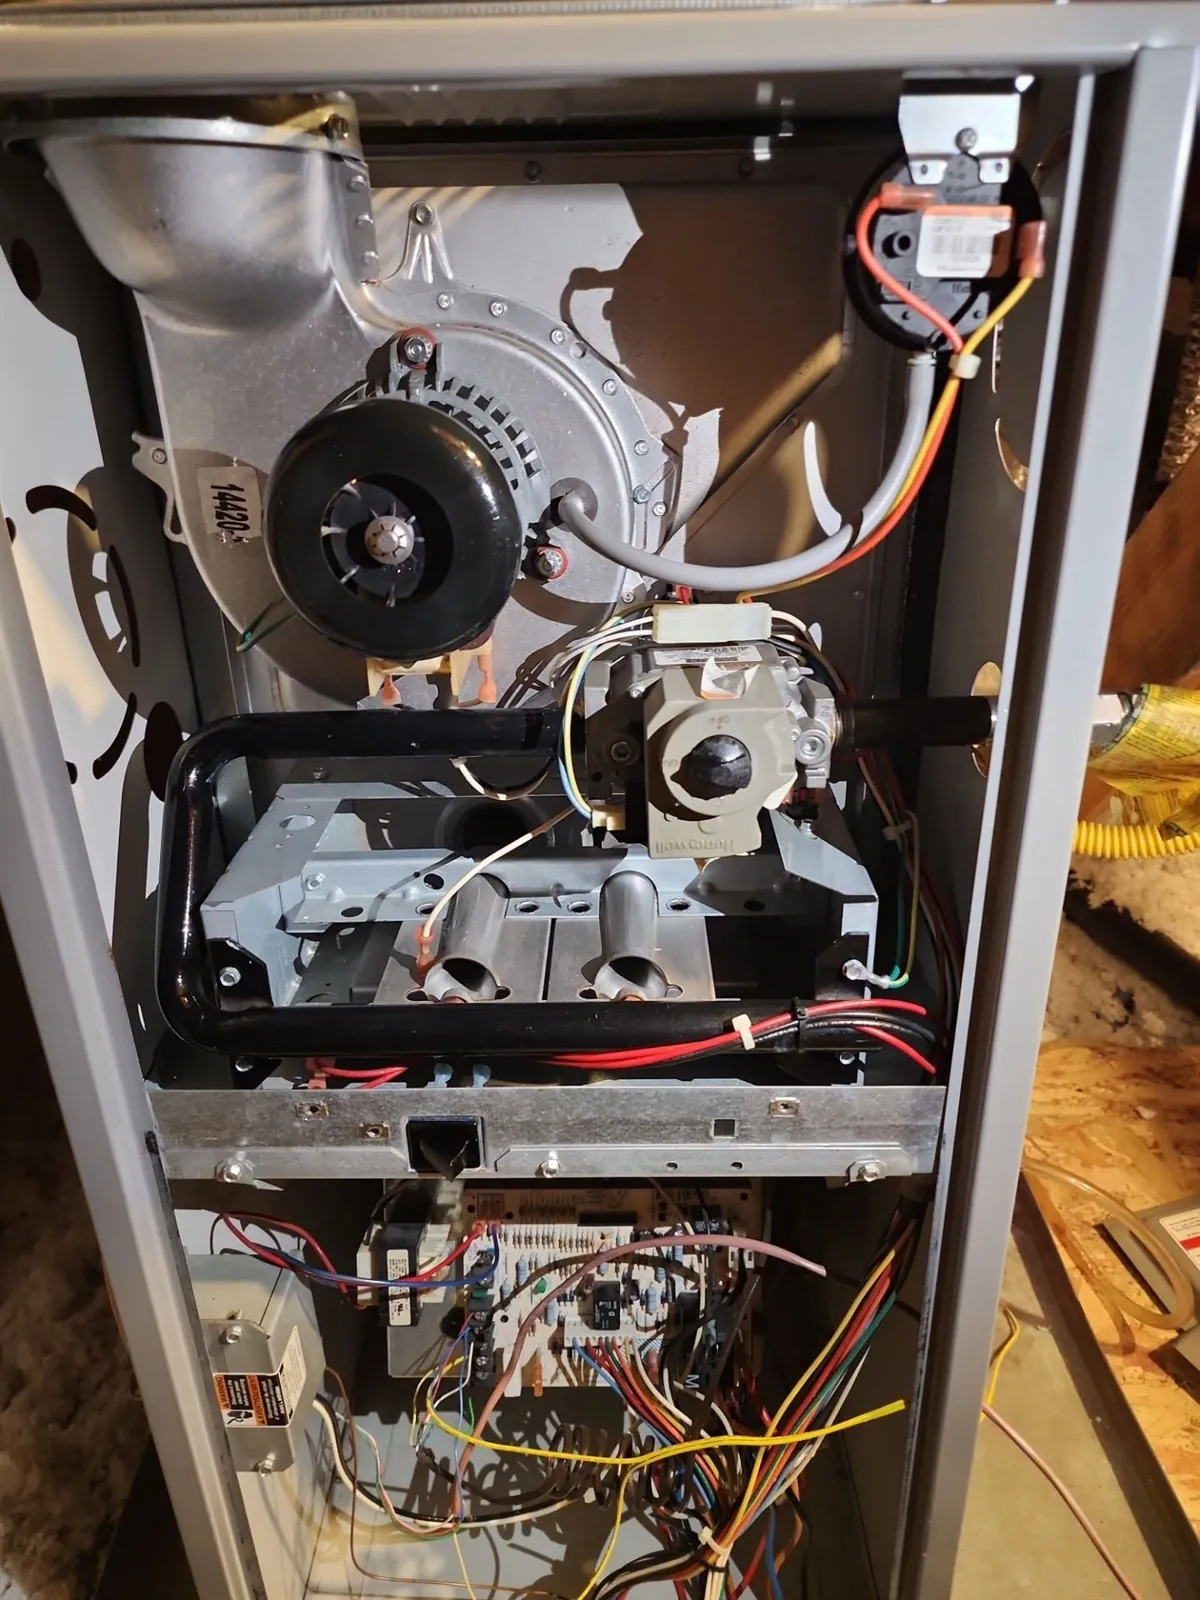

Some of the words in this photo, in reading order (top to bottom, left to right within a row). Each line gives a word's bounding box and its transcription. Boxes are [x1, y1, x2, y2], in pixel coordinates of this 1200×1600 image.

[708, 716, 730, 725] OFF
[655, 838, 735, 854] Honeywell
[215, 1376, 229, 1403] WARNING
